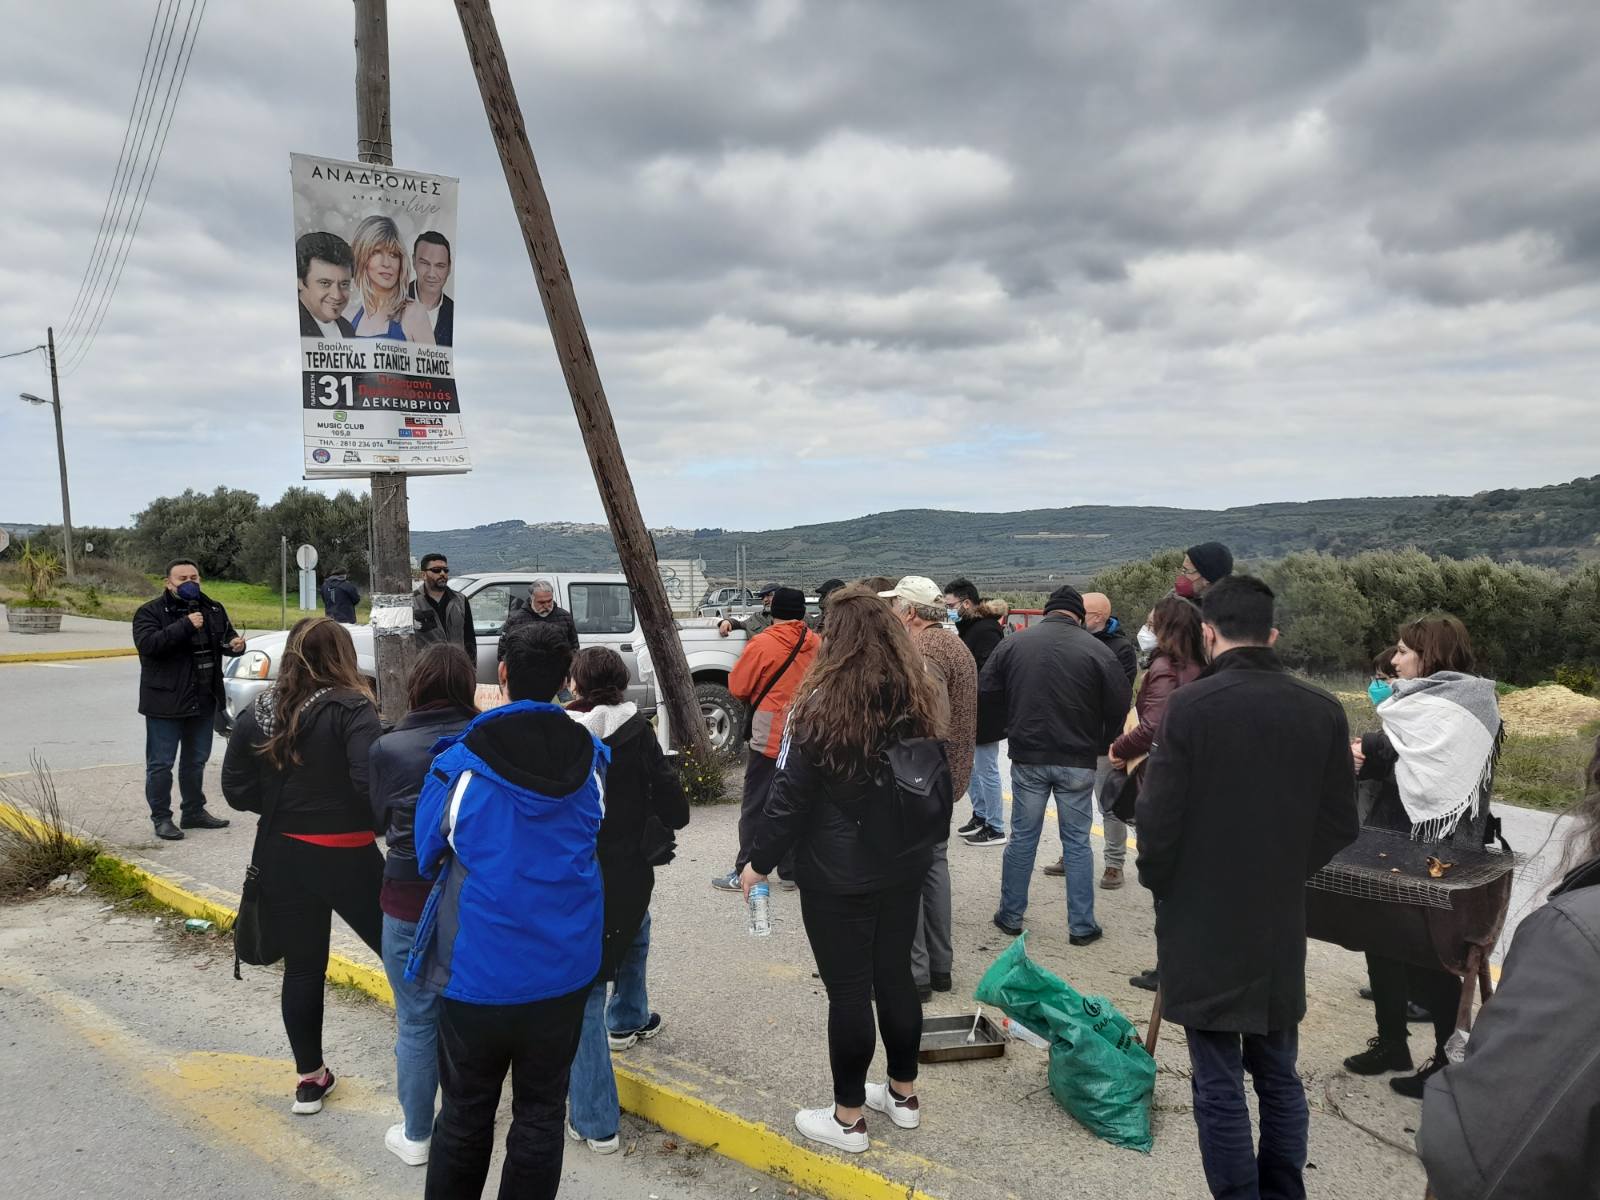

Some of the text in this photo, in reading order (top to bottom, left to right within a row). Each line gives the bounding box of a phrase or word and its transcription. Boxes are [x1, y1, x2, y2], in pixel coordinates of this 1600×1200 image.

[311, 165, 441, 196] ΑΝΑΔΡΟΜΕΣ
[317, 342, 448, 360] Βασίλης Κατερίνα Ανδρέας
[305, 351, 451, 376] ΤΕΡΛΕΓΚΑΣ ΣΤΑΝΙΣΗ ΣΤΑΜΟΣ
[318, 374, 354, 407] 31
[362, 397, 451, 411] ΔΕΚΕΜΒΡΙΟΥ
[317, 422, 342, 430] MUSIC
